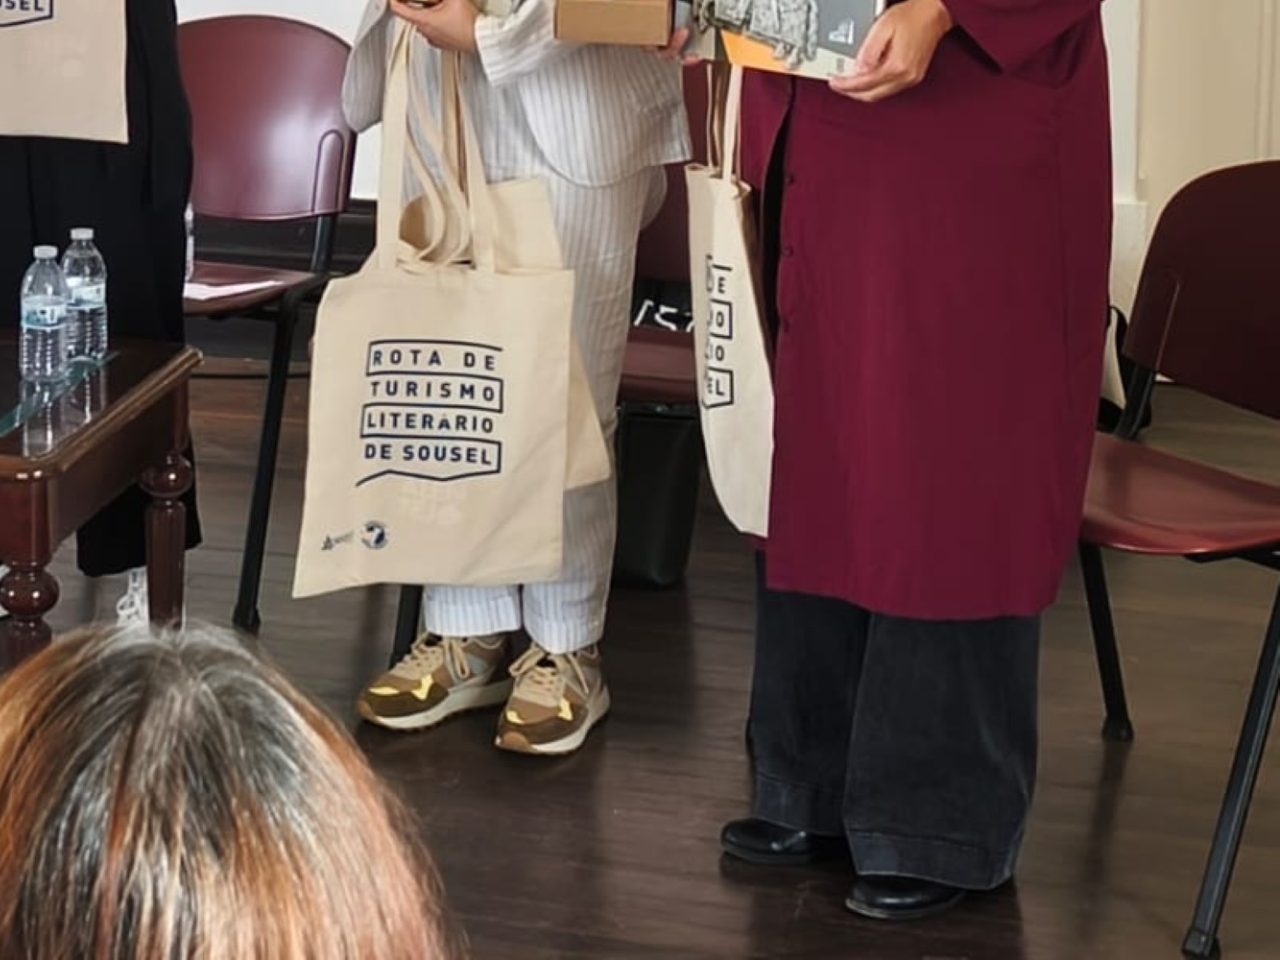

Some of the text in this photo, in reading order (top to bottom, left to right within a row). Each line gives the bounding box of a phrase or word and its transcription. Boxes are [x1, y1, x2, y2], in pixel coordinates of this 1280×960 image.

[372, 349, 495, 371] ROTA DE
[370, 380, 495, 402] TURISMO
[364, 443, 492, 466] DE SOUSEL
